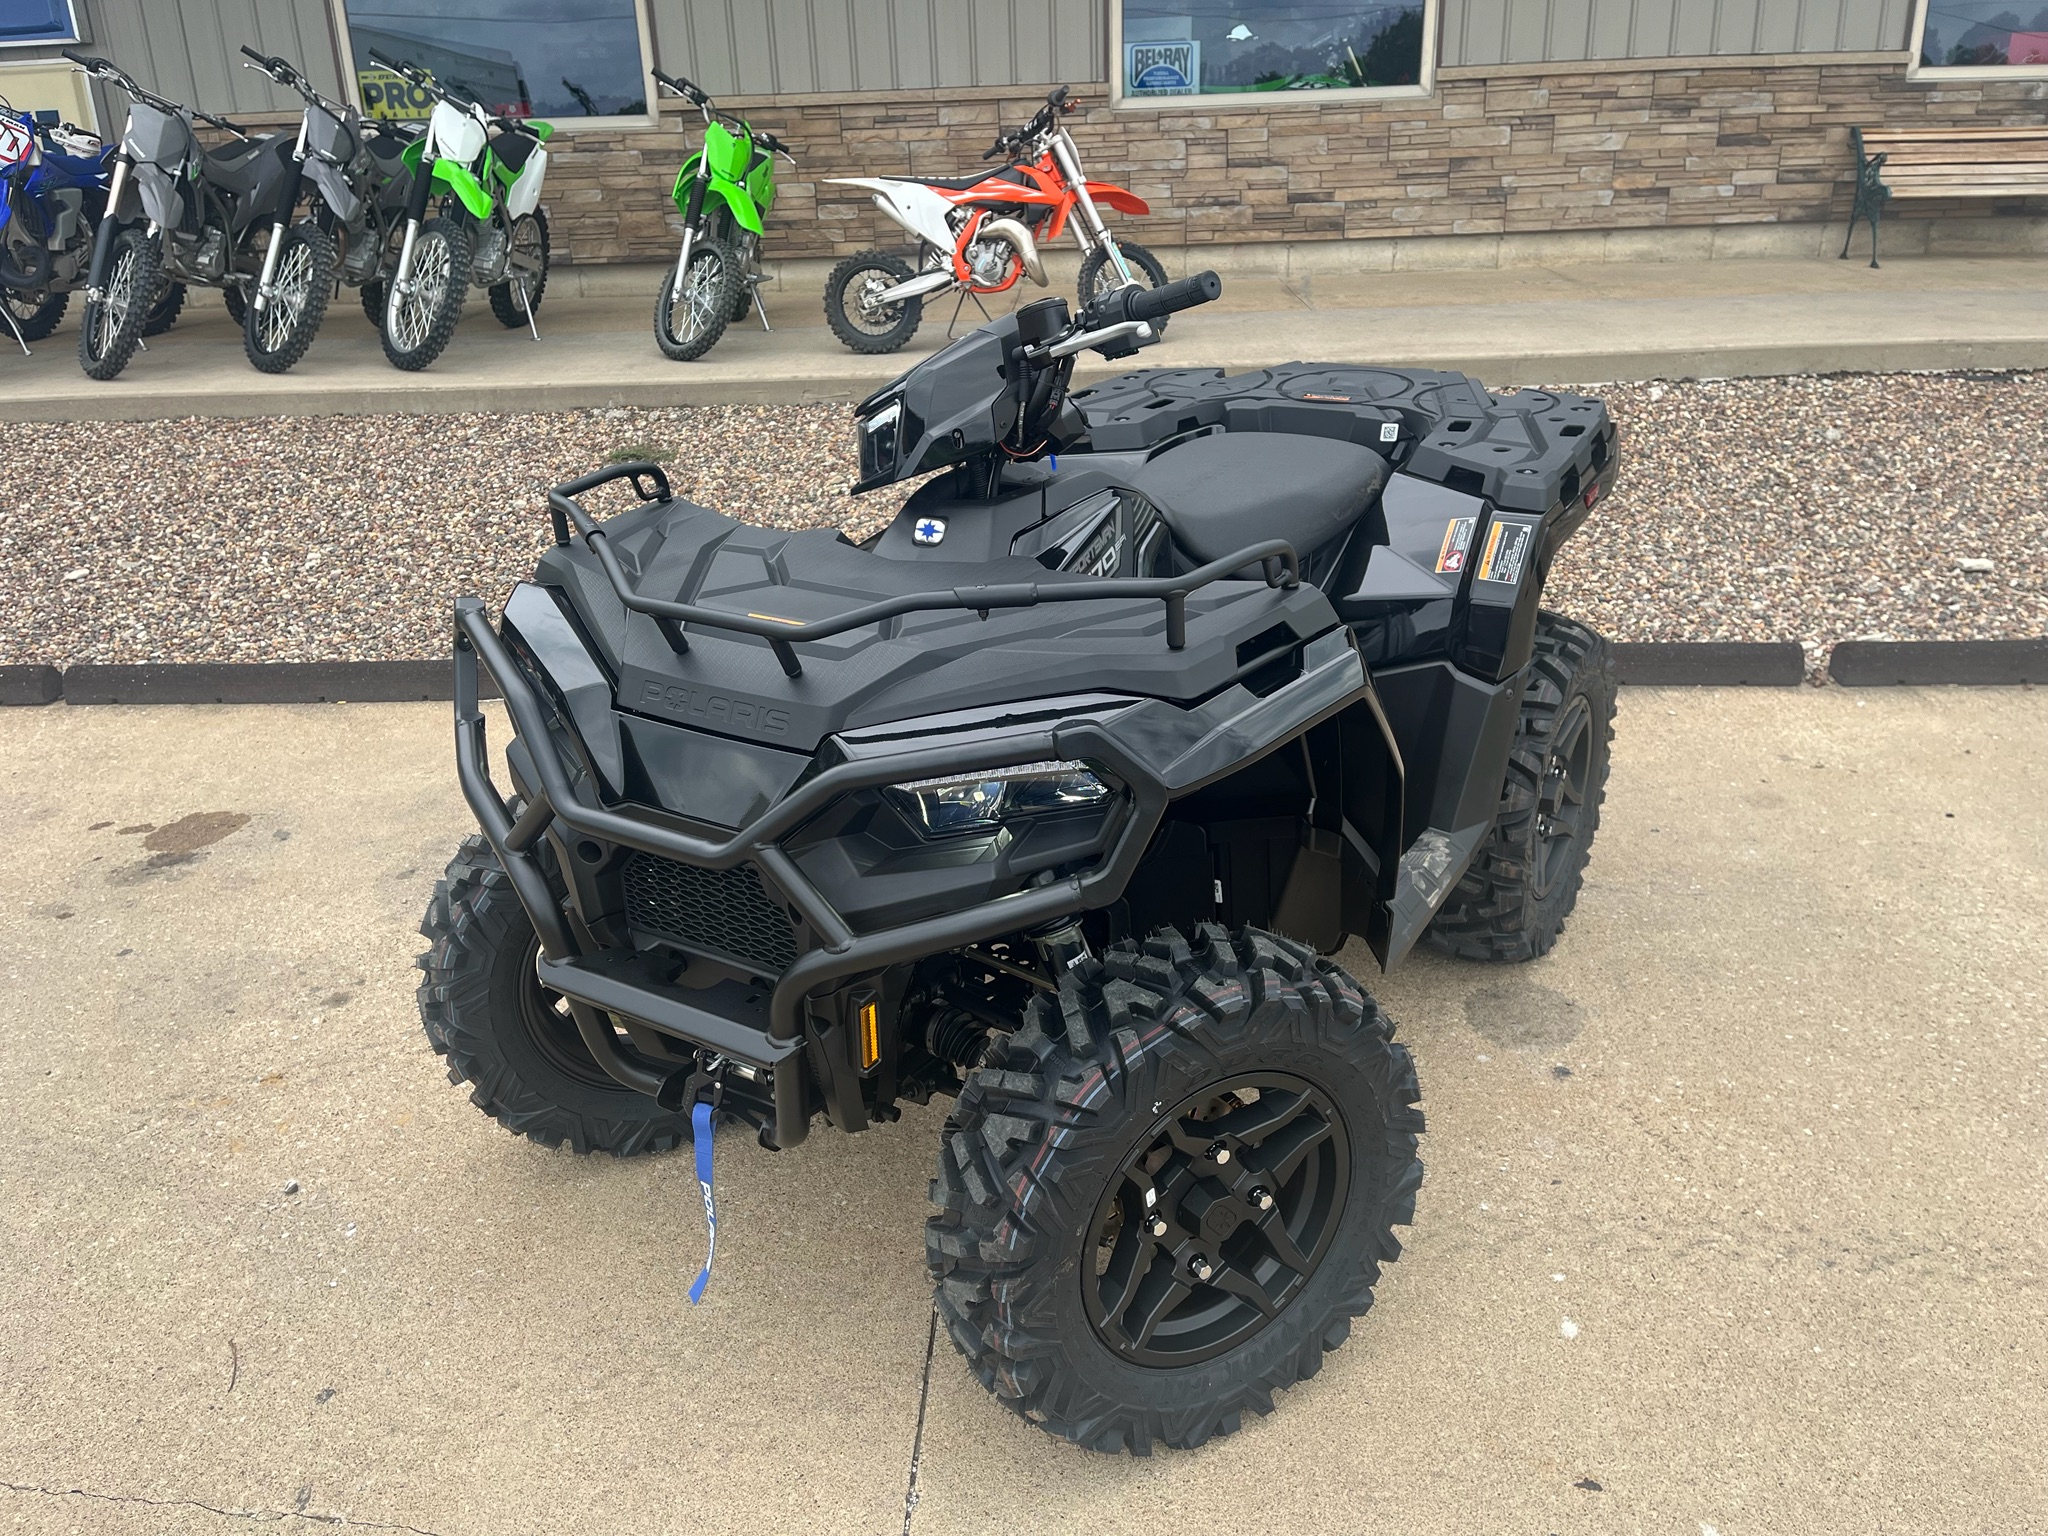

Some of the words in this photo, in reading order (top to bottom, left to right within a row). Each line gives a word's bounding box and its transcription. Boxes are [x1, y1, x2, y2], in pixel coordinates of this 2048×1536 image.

[362, 82, 433, 110] PRO
[1131, 89, 1168, 97] AUTHORIZED
[1169, 88, 1193, 96] DEALER
[1087, 545, 1117, 577] 70
[640, 679, 791, 737] POLARIS
